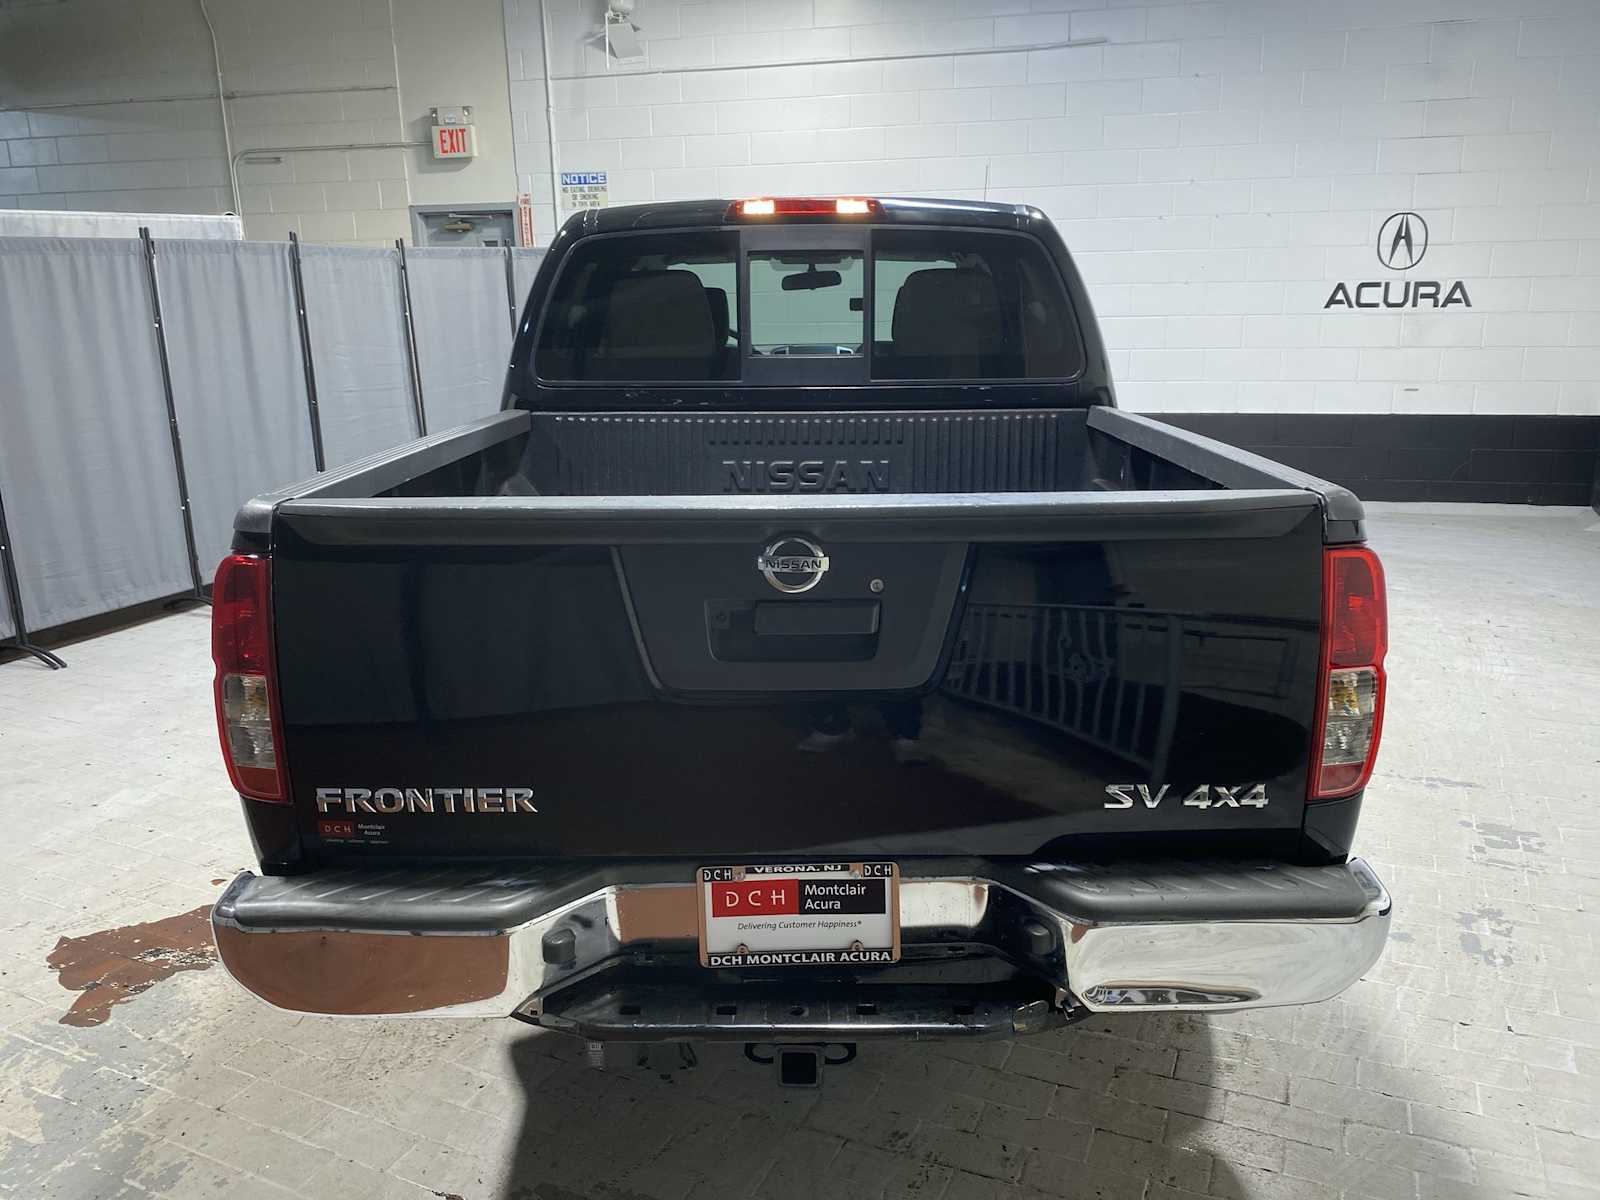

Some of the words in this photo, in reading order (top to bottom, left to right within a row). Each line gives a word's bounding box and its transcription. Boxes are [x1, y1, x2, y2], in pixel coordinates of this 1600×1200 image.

[439, 128, 467, 154] EXIT
[562, 173, 606, 184] NOTICE
[1324, 281, 1472, 309] ACURA
[723, 460, 890, 492] NISSAN
[765, 559, 822, 569] NISSAN
[315, 787, 538, 813] FRONTIER
[1104, 783, 1171, 809] SV
[823, 864, 842, 872] NJ
[804, 883, 866, 896] Montclair
[804, 899, 841, 910] Acura
[737, 920, 777, 931] Delivering
[778, 920, 817, 930] Customer
[710, 955, 742, 966] DCH
[746, 952, 835, 965] MONTCLAIR
[840, 951, 891, 962] ACURA
